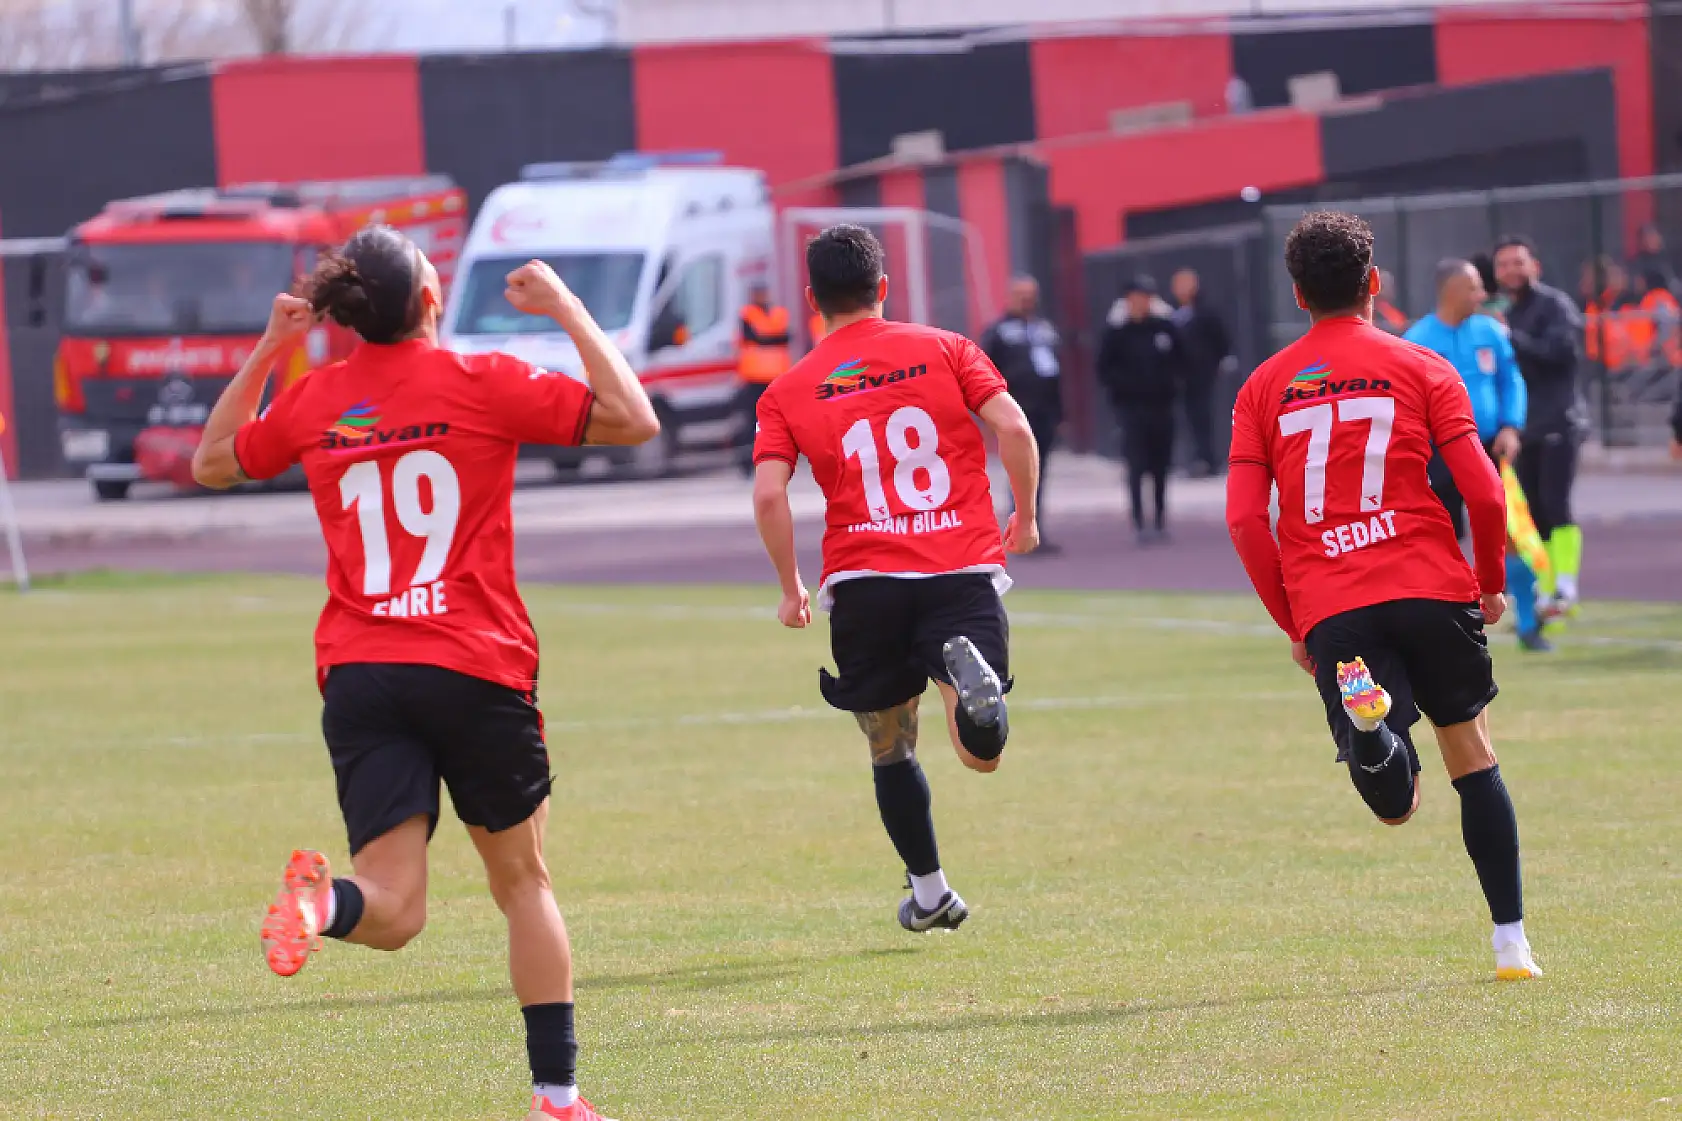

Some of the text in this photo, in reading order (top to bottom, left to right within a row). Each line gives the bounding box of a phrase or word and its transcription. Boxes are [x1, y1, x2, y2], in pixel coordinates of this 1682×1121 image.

[842, 406, 951, 521] 18
[1278, 397, 1395, 524] 77
[339, 450, 460, 596] 19
[1321, 510, 1396, 558] SEDAT
